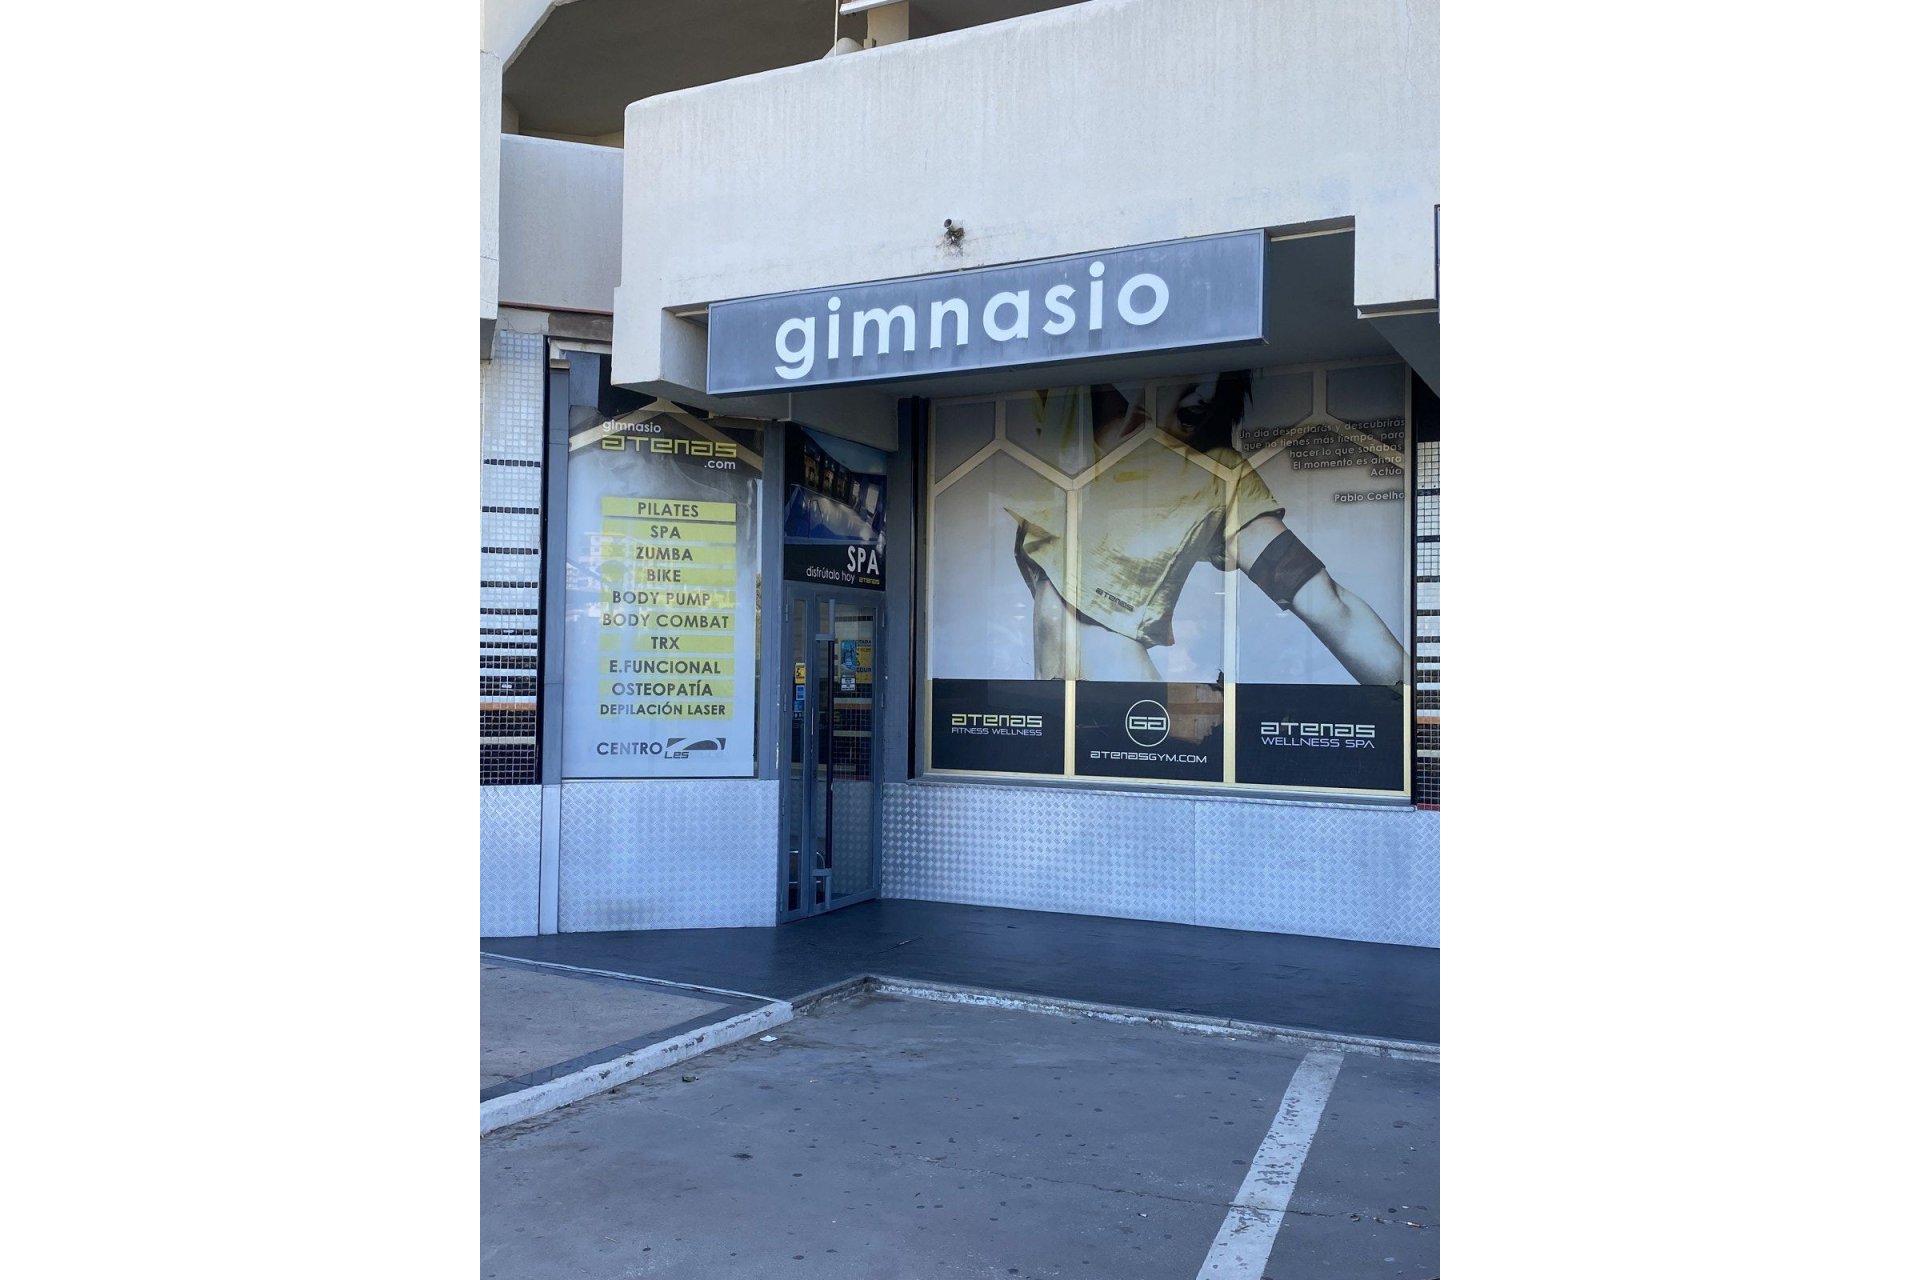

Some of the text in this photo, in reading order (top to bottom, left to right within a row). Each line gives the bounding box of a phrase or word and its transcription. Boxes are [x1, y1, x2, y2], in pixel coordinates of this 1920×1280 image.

[775, 261, 1169, 380] gimnasio
[602, 419, 662, 433] gimnasio
[1335, 424, 1340, 433] y
[1344, 419, 1405, 430] descubrirás
[1243, 441, 1262, 450] que
[1265, 440, 1278, 448] no
[1280, 437, 1310, 447] tienes
[1313, 435, 1334, 445] más
[1380, 431, 1404, 442] para
[1290, 443, 1402, 459] hacer lo que soñabas
[704, 460, 736, 470] .com
[1293, 455, 1402, 470] El momento es ahora
[1371, 467, 1402, 477] Actúa
[1334, 493, 1363, 502] Pablo
[637, 502, 699, 518] PILATES
[650, 525, 681, 539] SPA
[636, 546, 693, 561] ZUMBA
[847, 545, 879, 575] SPA
[647, 569, 681, 582] BIKE
[806, 565, 855, 584] disfrútalo hoy
[612, 590, 711, 606] BODY PUMP
[602, 613, 729, 628] BODY COMBAT
[651, 637, 680, 650] TRX
[610, 660, 721, 674] E.FUNCIONAL
[612, 680, 713, 696] OSTEOPATÍA
[600, 701, 726, 715] DEPILACIÓN LASER
[951, 727, 1042, 736] FITNESS WELLNESS
[597, 742, 663, 755] CENTRO
[1261, 737, 1375, 749] WELLNESS SPA
